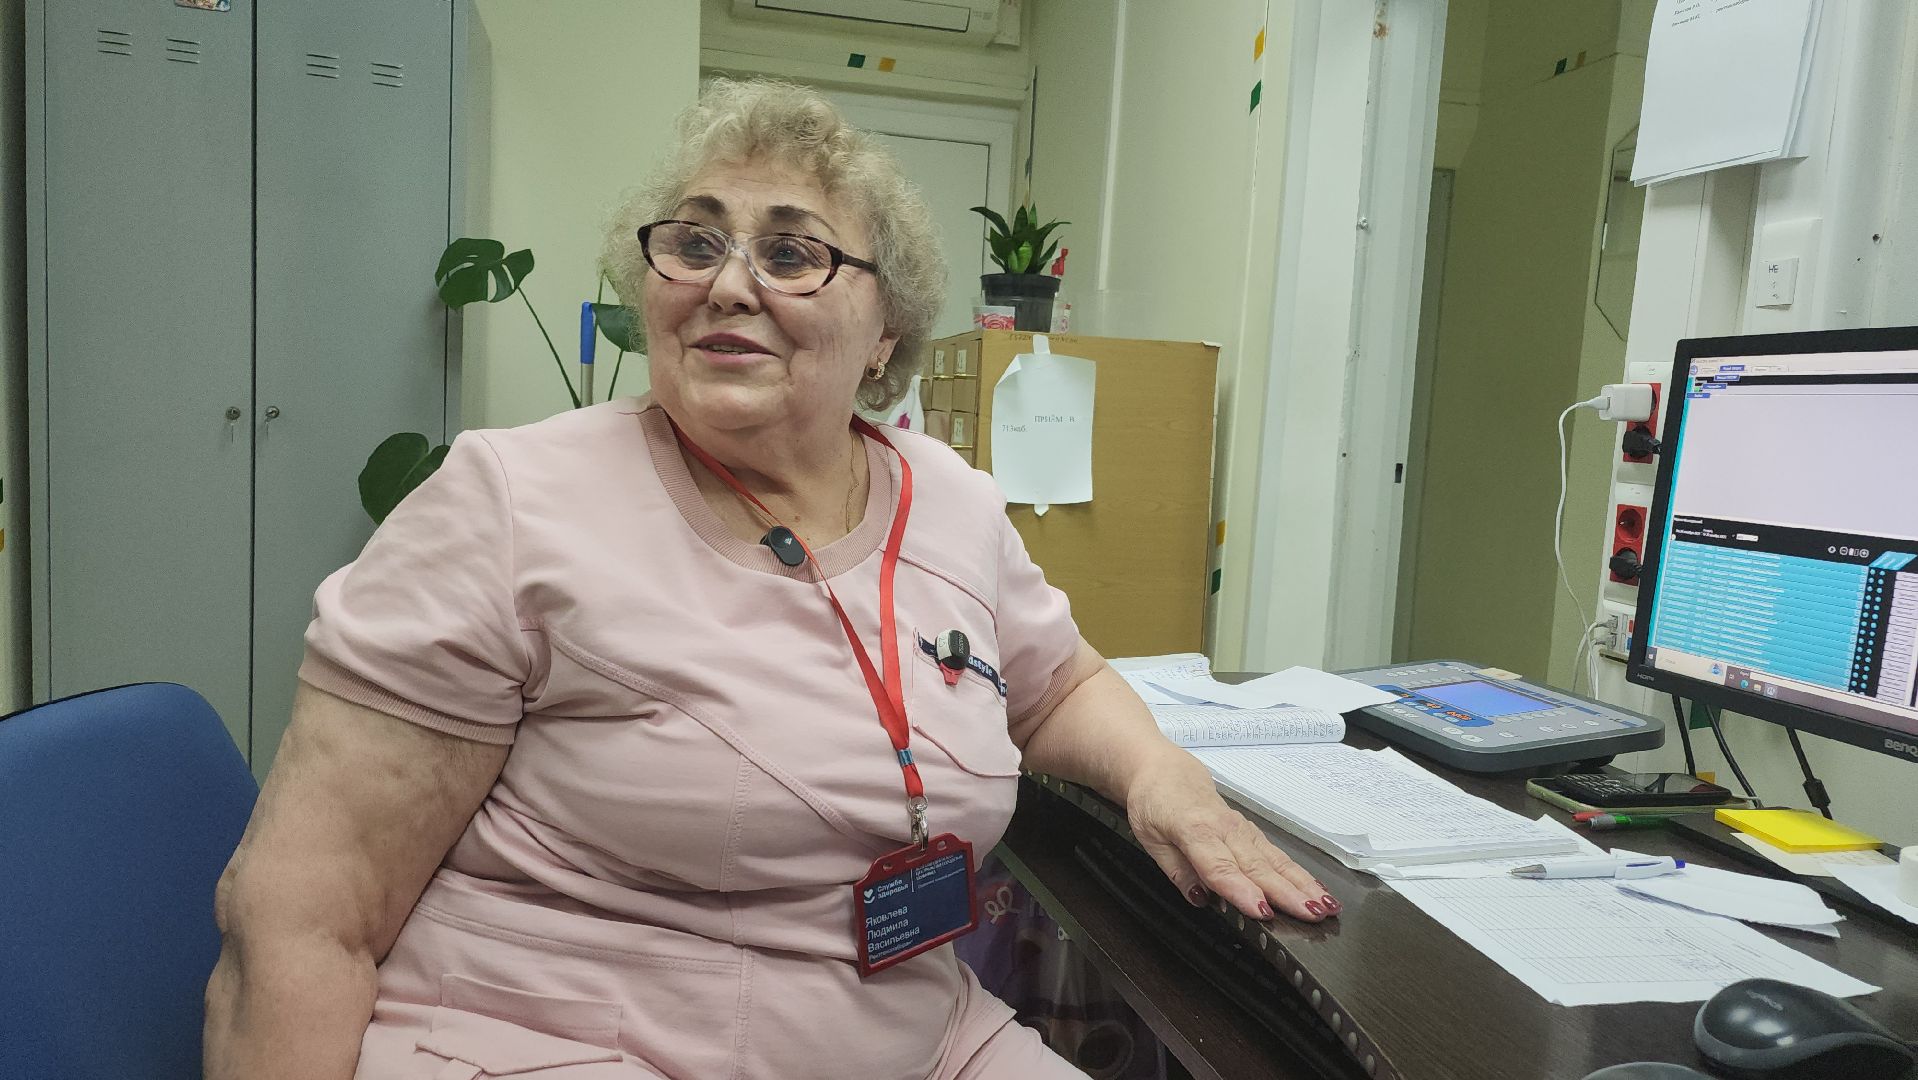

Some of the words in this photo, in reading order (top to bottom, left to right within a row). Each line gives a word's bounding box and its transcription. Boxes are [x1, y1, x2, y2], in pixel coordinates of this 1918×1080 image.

[877, 879, 903, 893] Служба
[865, 905, 908, 928] Яковлева
[867, 919, 909, 941] Людмила
[868, 926, 920, 953] Васильевна
